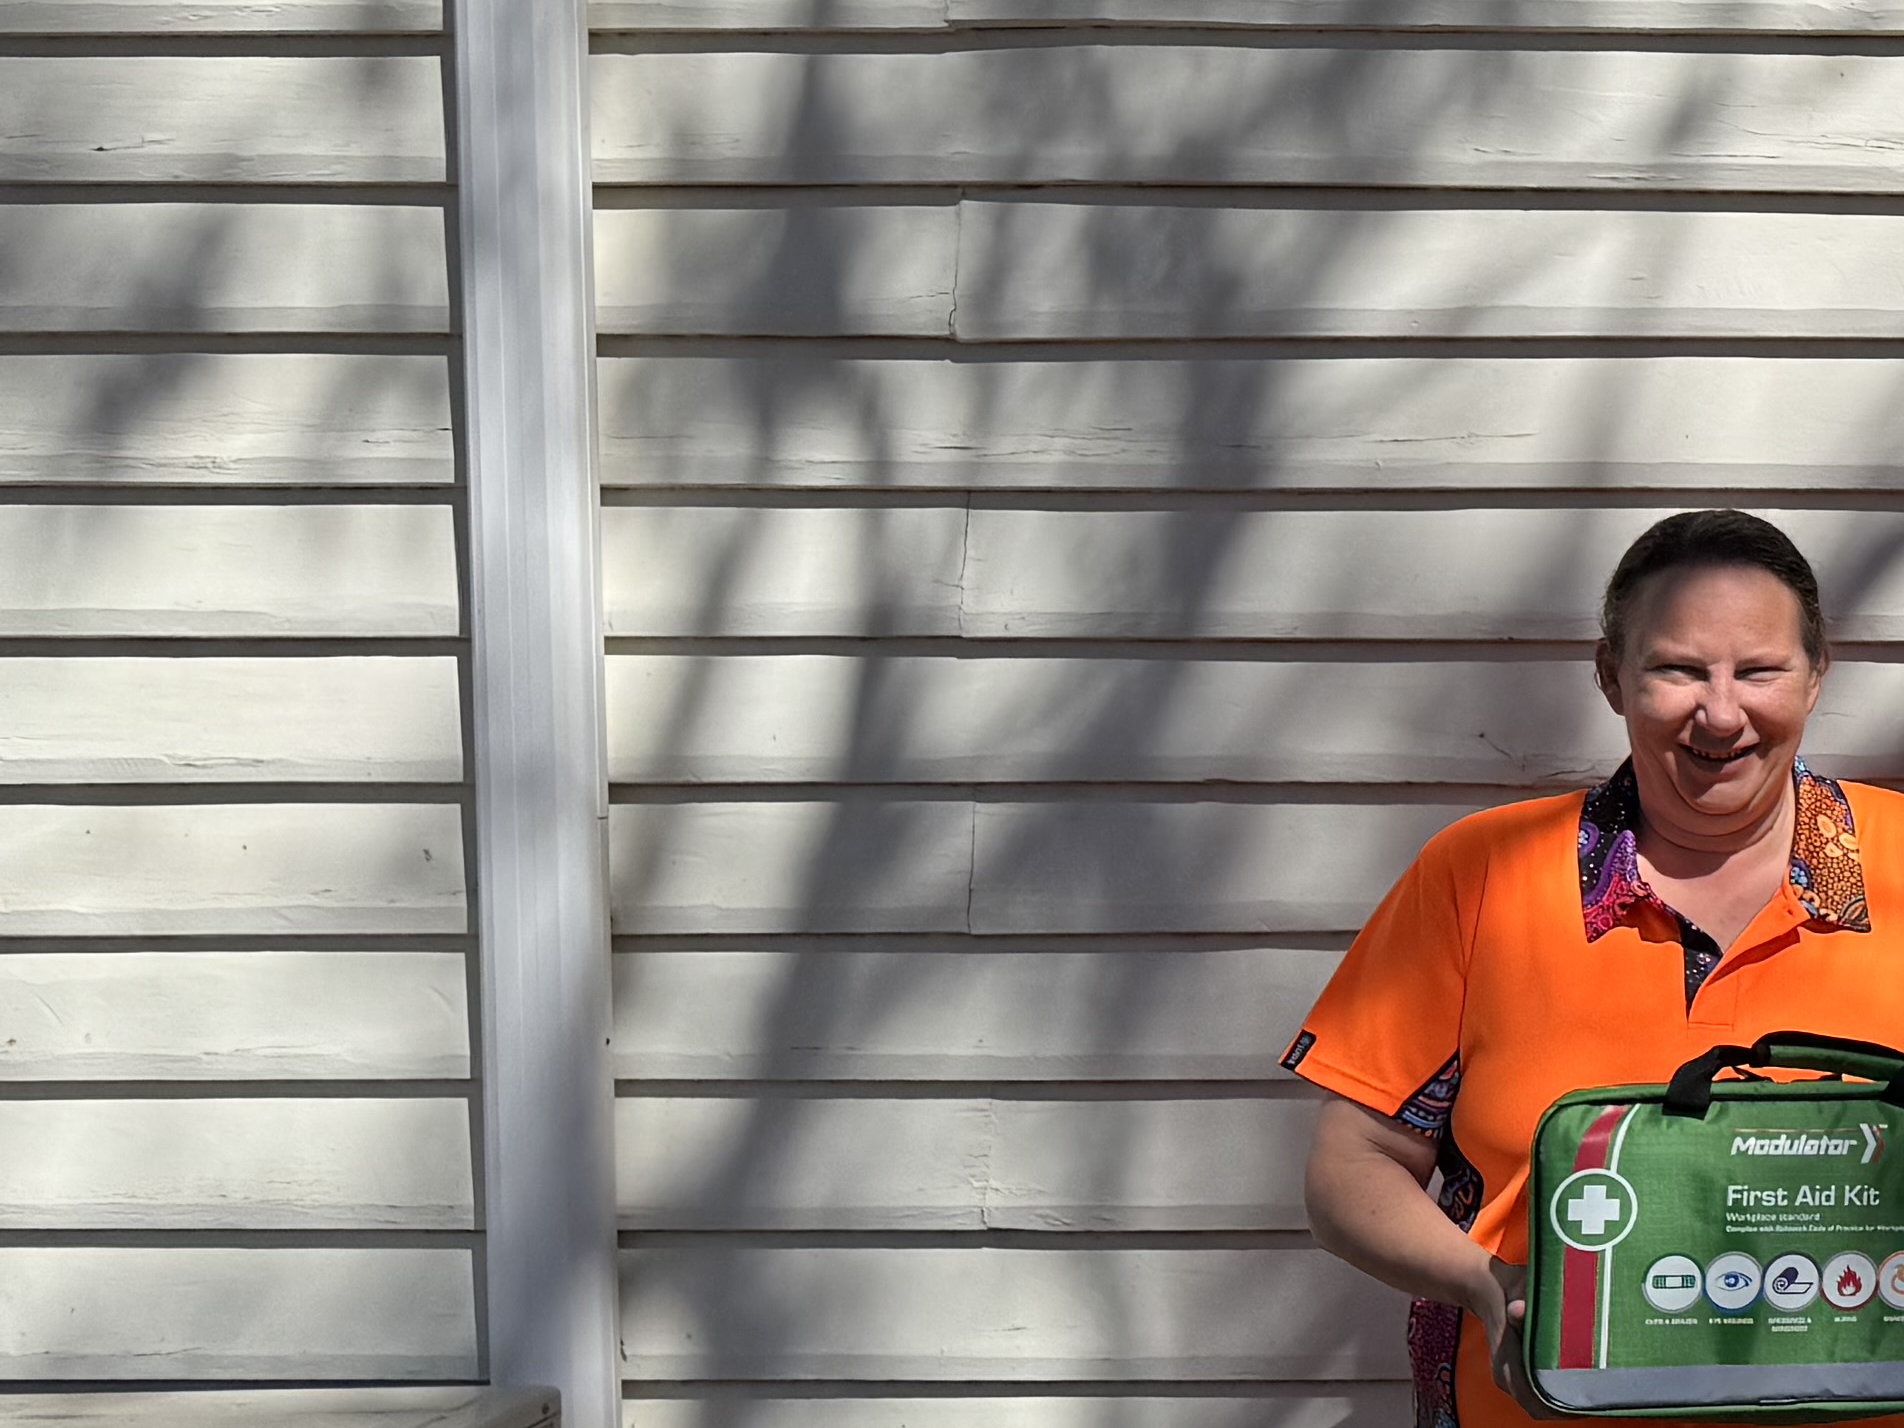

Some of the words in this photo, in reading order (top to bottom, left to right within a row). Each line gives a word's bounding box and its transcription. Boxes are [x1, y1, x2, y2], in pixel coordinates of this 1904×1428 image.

[1730, 1133, 1858, 1156] Modulator
[1726, 1185, 1788, 1207] First
[1795, 1185, 1836, 1206] Aid
[1844, 1184, 1881, 1206] Kit
